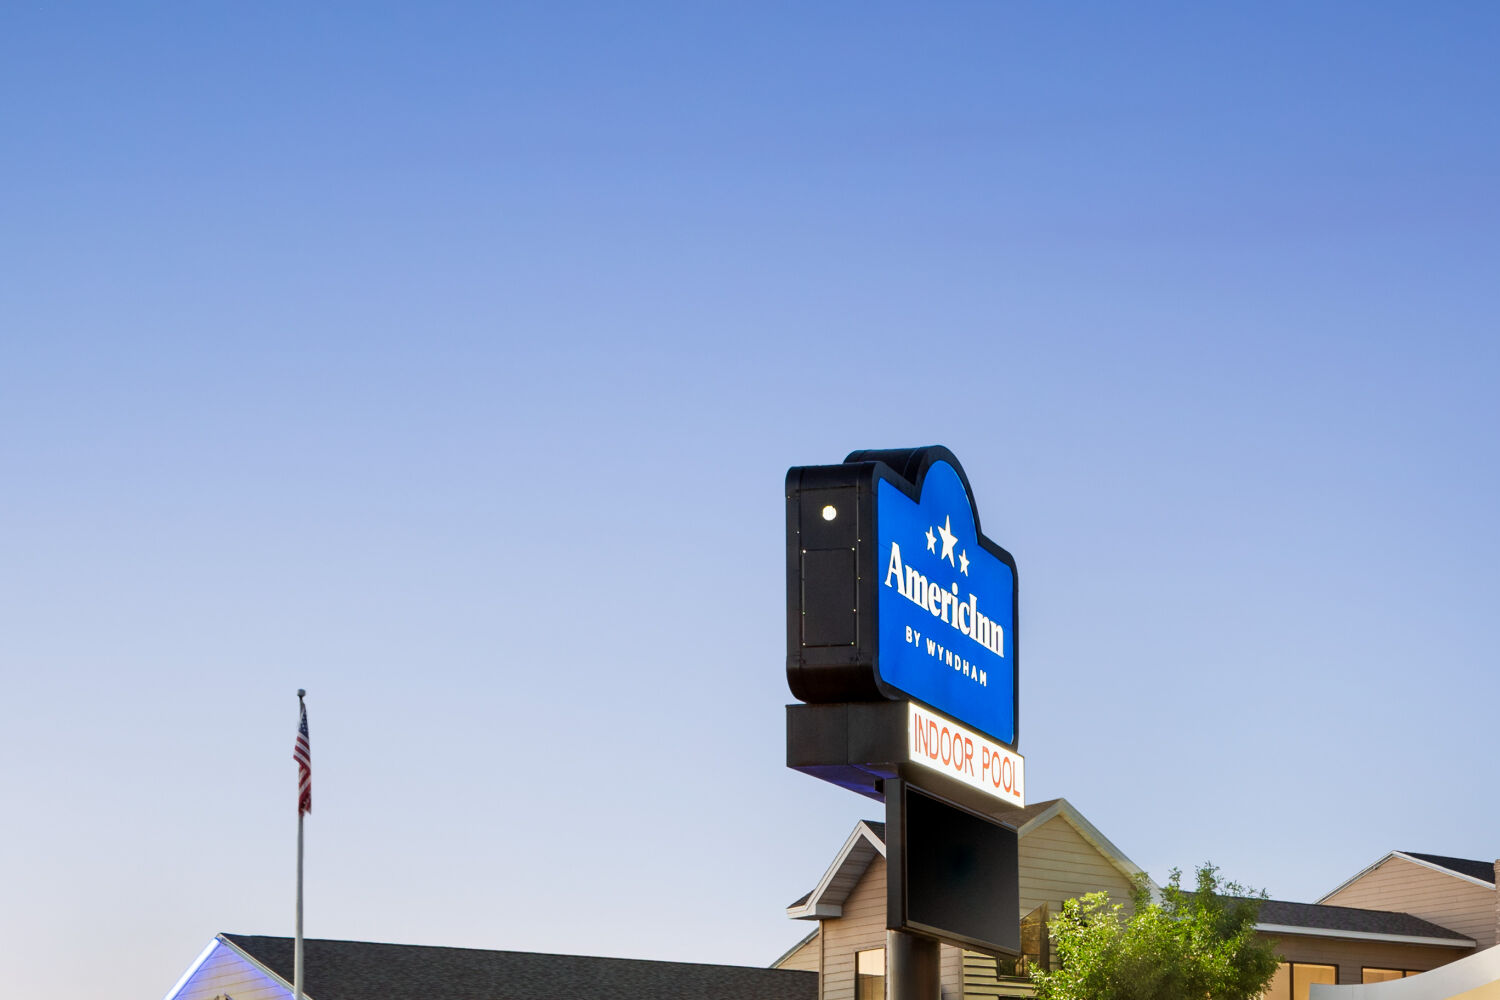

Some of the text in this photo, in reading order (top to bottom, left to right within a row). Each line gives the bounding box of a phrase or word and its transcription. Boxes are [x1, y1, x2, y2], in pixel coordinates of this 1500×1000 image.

[885, 542, 1004, 657] AmericInn
[906, 626, 987, 686] BY WYNDHAM
[914, 713, 1020, 798] INDOOR POOL
